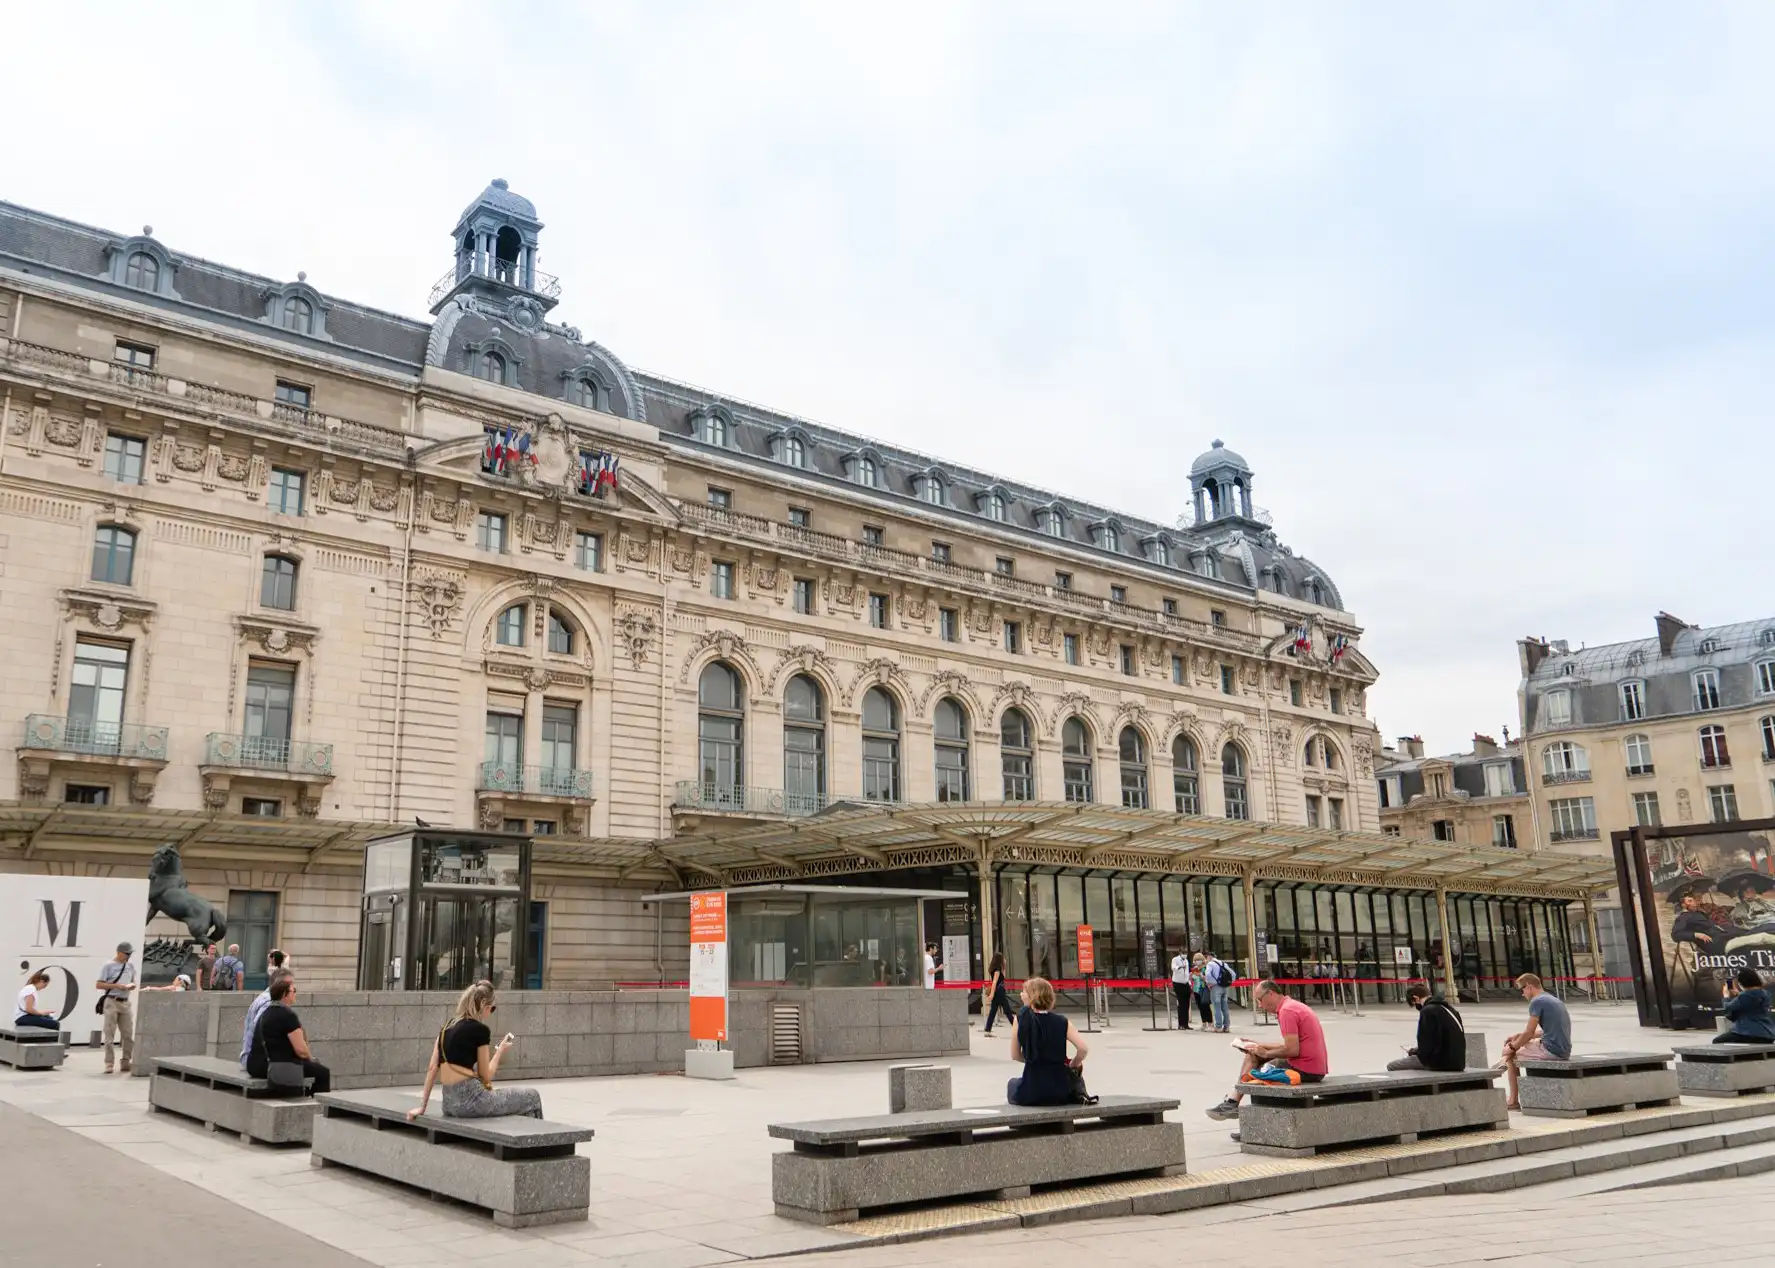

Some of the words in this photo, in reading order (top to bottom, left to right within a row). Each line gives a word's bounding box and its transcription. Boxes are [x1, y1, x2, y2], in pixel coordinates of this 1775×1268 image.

[30, 899, 86, 948] M
[1017, 906, 1026, 919] A
[1691, 950, 1748, 973] James
